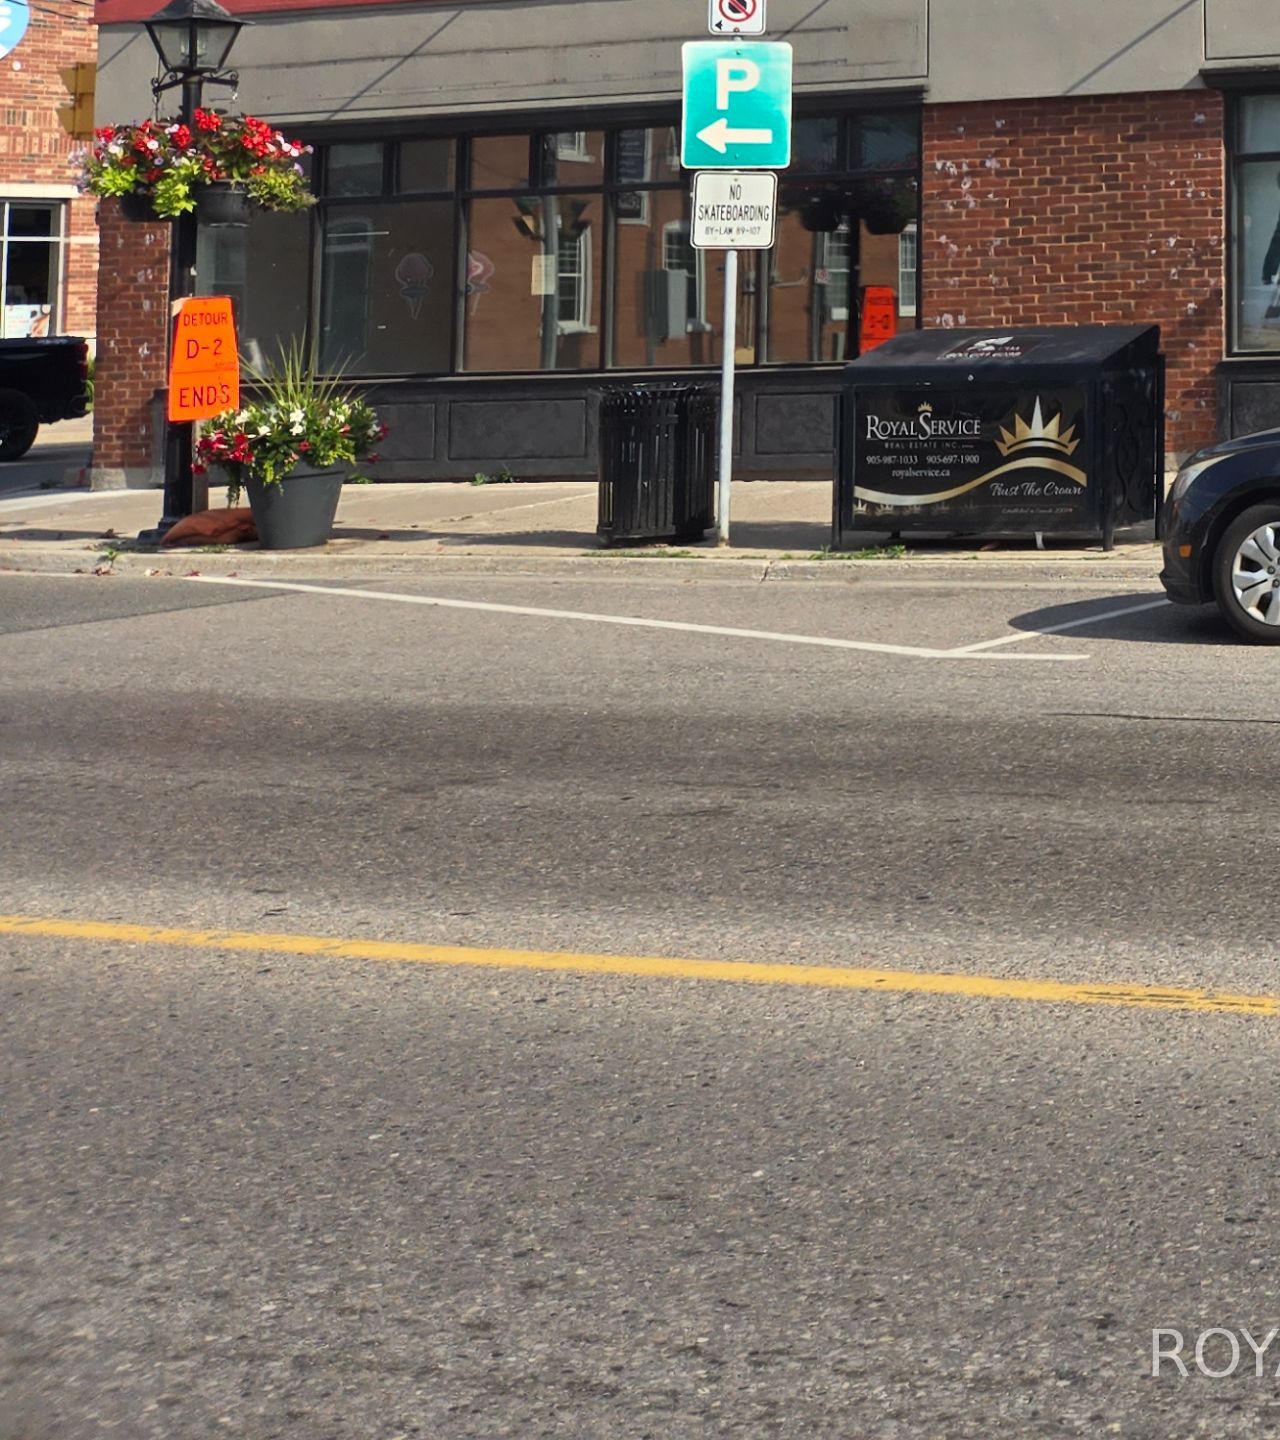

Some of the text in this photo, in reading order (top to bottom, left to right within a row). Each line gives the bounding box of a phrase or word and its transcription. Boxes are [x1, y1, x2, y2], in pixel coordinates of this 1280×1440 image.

[716, 58, 760, 110] P
[729, 184, 742, 201] NO
[698, 204, 770, 221] SKATEBOARDING
[705, 226, 733, 235] BY-LAW
[183, 312, 228, 327] DETOUR
[186, 339, 222, 359] D-2
[179, 384, 230, 408] ENDS
[866, 412, 981, 440] ROYAL SERVICE
[909, 441, 937, 449] ESTATE
[892, 467, 951, 479] royalservice.ca
[990, 481, 1083, 496] Trust The Crown
